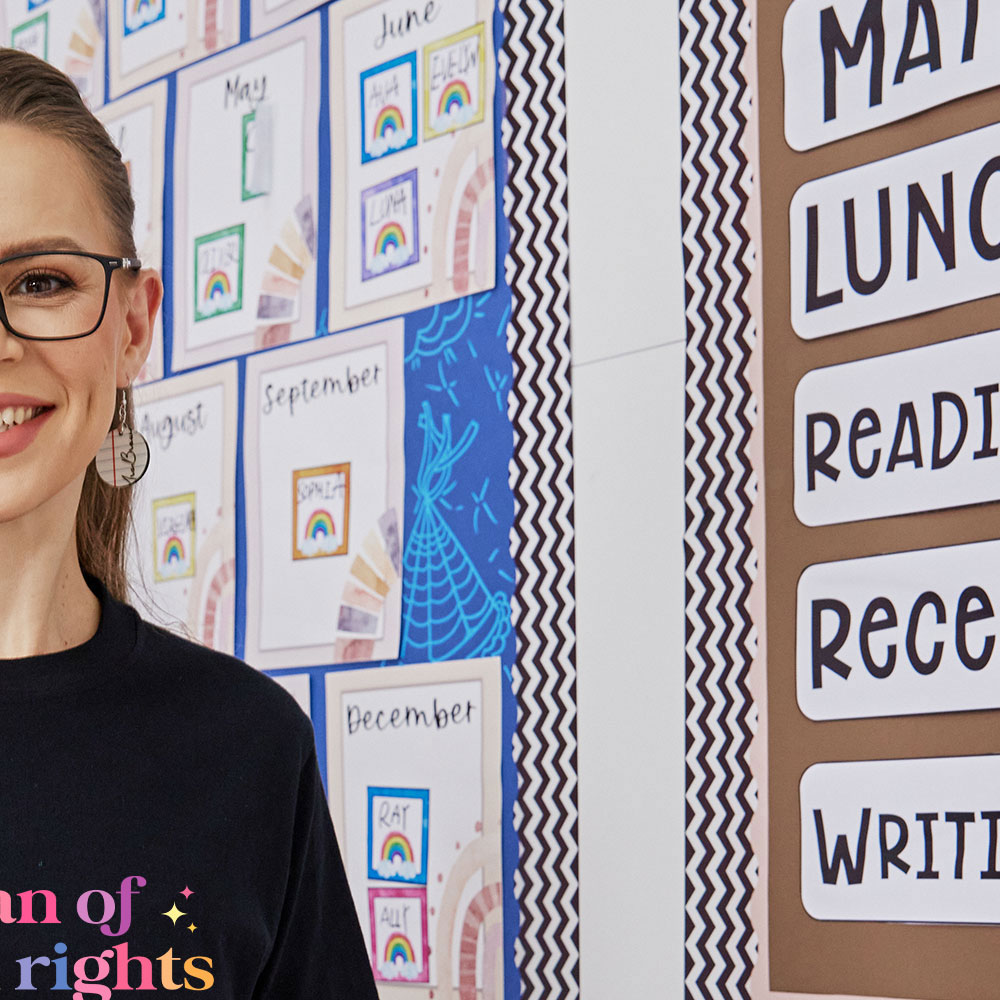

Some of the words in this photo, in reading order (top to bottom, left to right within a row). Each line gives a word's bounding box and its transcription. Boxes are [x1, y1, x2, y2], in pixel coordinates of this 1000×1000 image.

[374, 0, 434, 50] June
[224, 75, 267, 110] May
[263, 364, 380, 416] September
[140, 402, 208, 452] August
[346, 698, 477, 735] December
[812, 807, 1000, 886] WRITI
[76, 876, 147, 937] of
